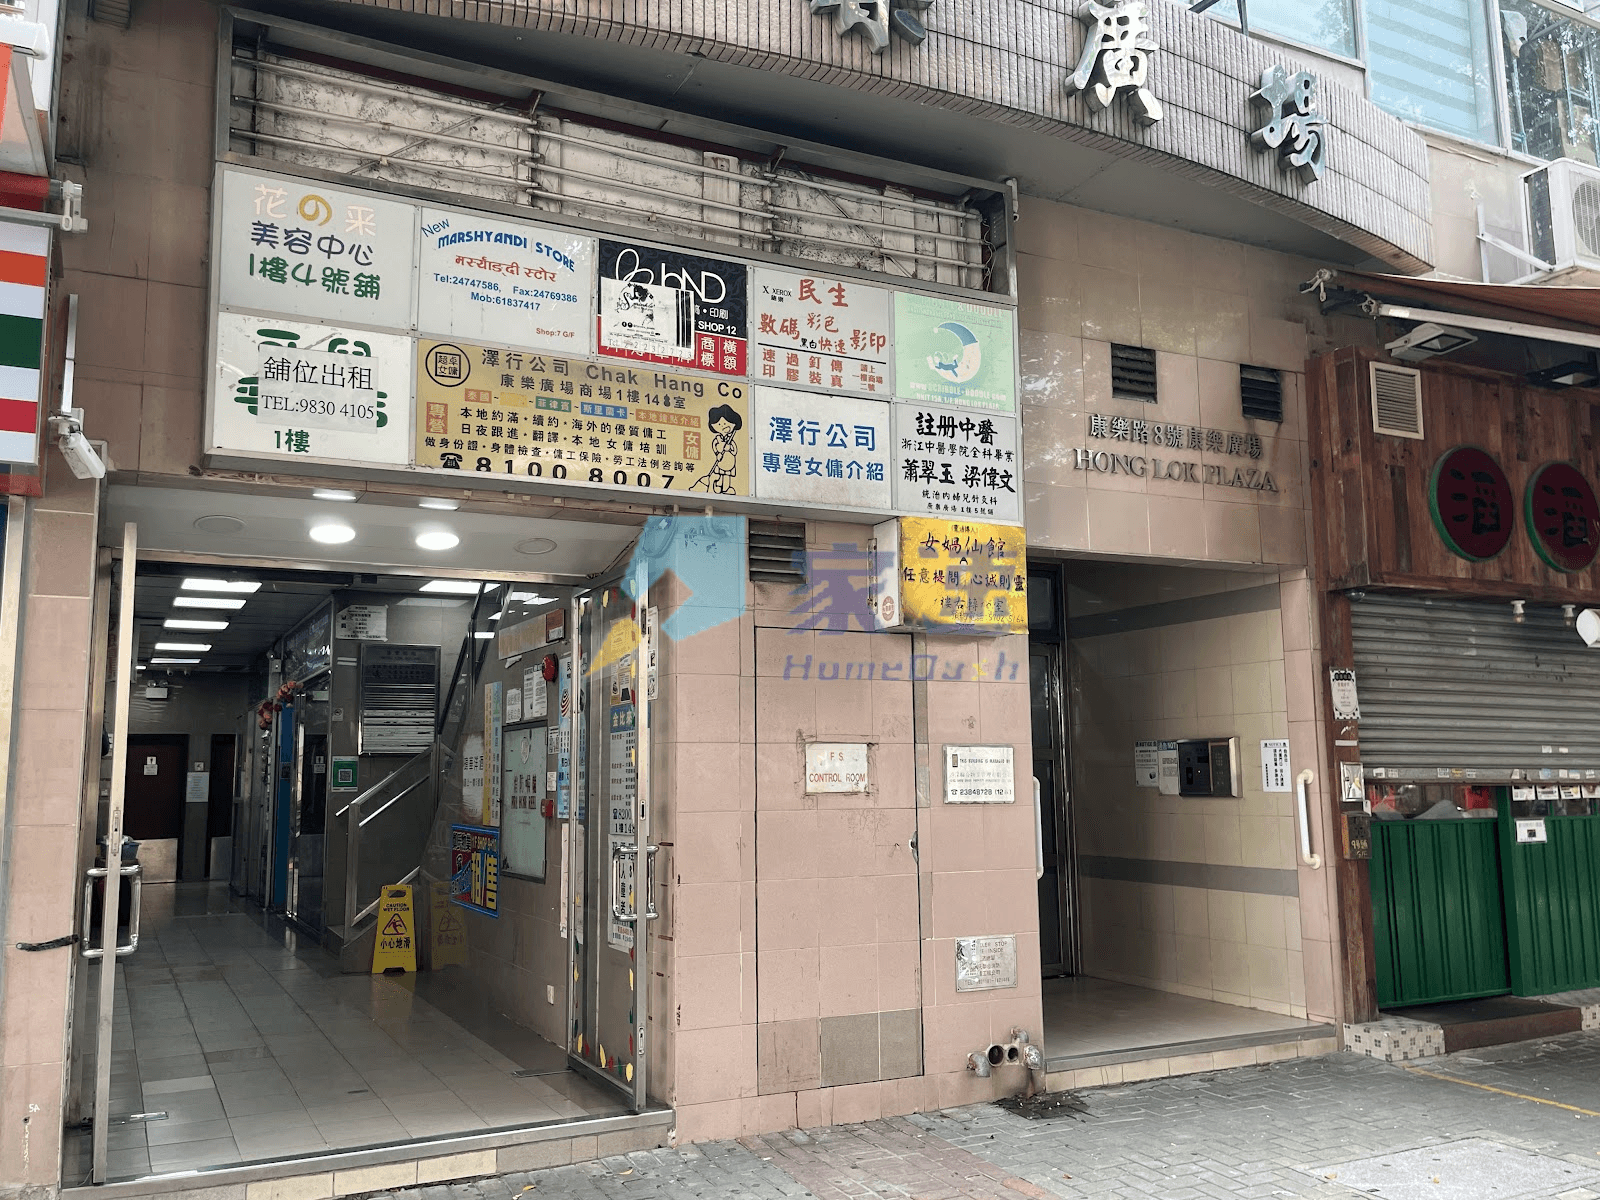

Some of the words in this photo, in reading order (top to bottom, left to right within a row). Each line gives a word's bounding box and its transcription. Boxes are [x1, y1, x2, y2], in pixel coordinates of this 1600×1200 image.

[250, 220, 374, 266] 美容中心
[421, 218, 451, 238] New
[438, 230, 528, 249] MARSHYANDI
[535, 241, 576, 272] STORE
[434, 273, 502, 293] Tel:24747586,
[513, 286, 578, 303] Fax:24769386
[523, 265, 557, 282] स्टोर
[470, 291, 541, 311] Mob:61837417
[762, 285, 770, 294] X
[772, 288, 792, 297] XEROX
[798, 279, 849, 307] 民生
[535, 328, 561, 337] Shop:7
[698, 321, 725, 331] SHOP
[726, 326, 737, 335] 12
[758, 313, 800, 340] 數碼
[807, 312, 839, 333] 彩色
[850, 329, 886, 354] 影印
[701, 337, 715, 368] 商標
[723, 340, 738, 371] 橫額
[800, 338, 817, 349] 黑白
[818, 336, 847, 354] 快速
[264, 357, 374, 391] 舖位出租
[482, 349, 568, 376] 澤行公司
[586, 364, 639, 385] Chak
[654, 373, 704, 397] Hang
[717, 382, 742, 399] Co
[763, 348, 776, 378] 速印
[786, 352, 799, 382] 過膠
[809, 355, 821, 385] 釘裝
[261, 395, 336, 416] TEL:9830
[339, 402, 375, 419] 4105
[537, 398, 570, 411] 菲律賓
[583, 404, 626, 418] 斯里蘭卡
[274, 428, 310, 453] 1樓
[685, 432, 699, 459] 女傭
[769, 416, 876, 452] 澤行公司
[1089, 414, 1264, 460] 康樂路8號康樂廣場
[475, 457, 567, 479] 8100
[588, 468, 675, 489] 8007
[762, 452, 884, 482] 專營女傭介紹
[902, 459, 955, 485] 蕭翠玉
[961, 464, 1016, 492] 梁偉文
[1074, 448, 1147, 477] HONG
[1152, 458, 1200, 483] LOK
[1203, 464, 1279, 492] PLAZA
[903, 567, 959, 586] 任意提問
[808, 773, 842, 783] CONTROL
[845, 773, 866, 783] ROOM
[380, 936, 411, 949] 小心地滑
